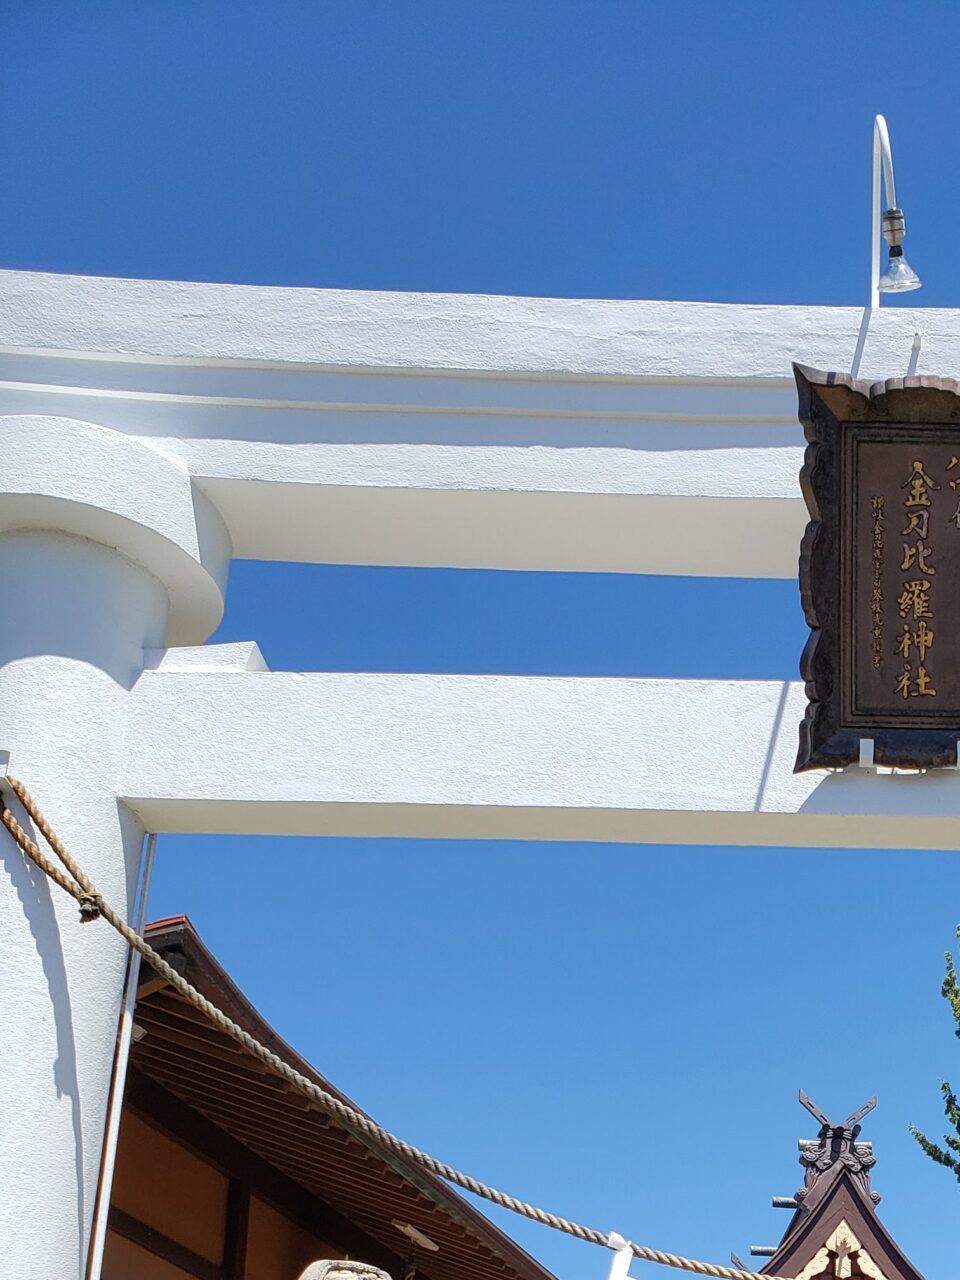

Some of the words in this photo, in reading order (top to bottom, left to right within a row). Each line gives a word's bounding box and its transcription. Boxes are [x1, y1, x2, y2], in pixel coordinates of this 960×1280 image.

[893, 460, 941, 700] 金刀比羅神社
